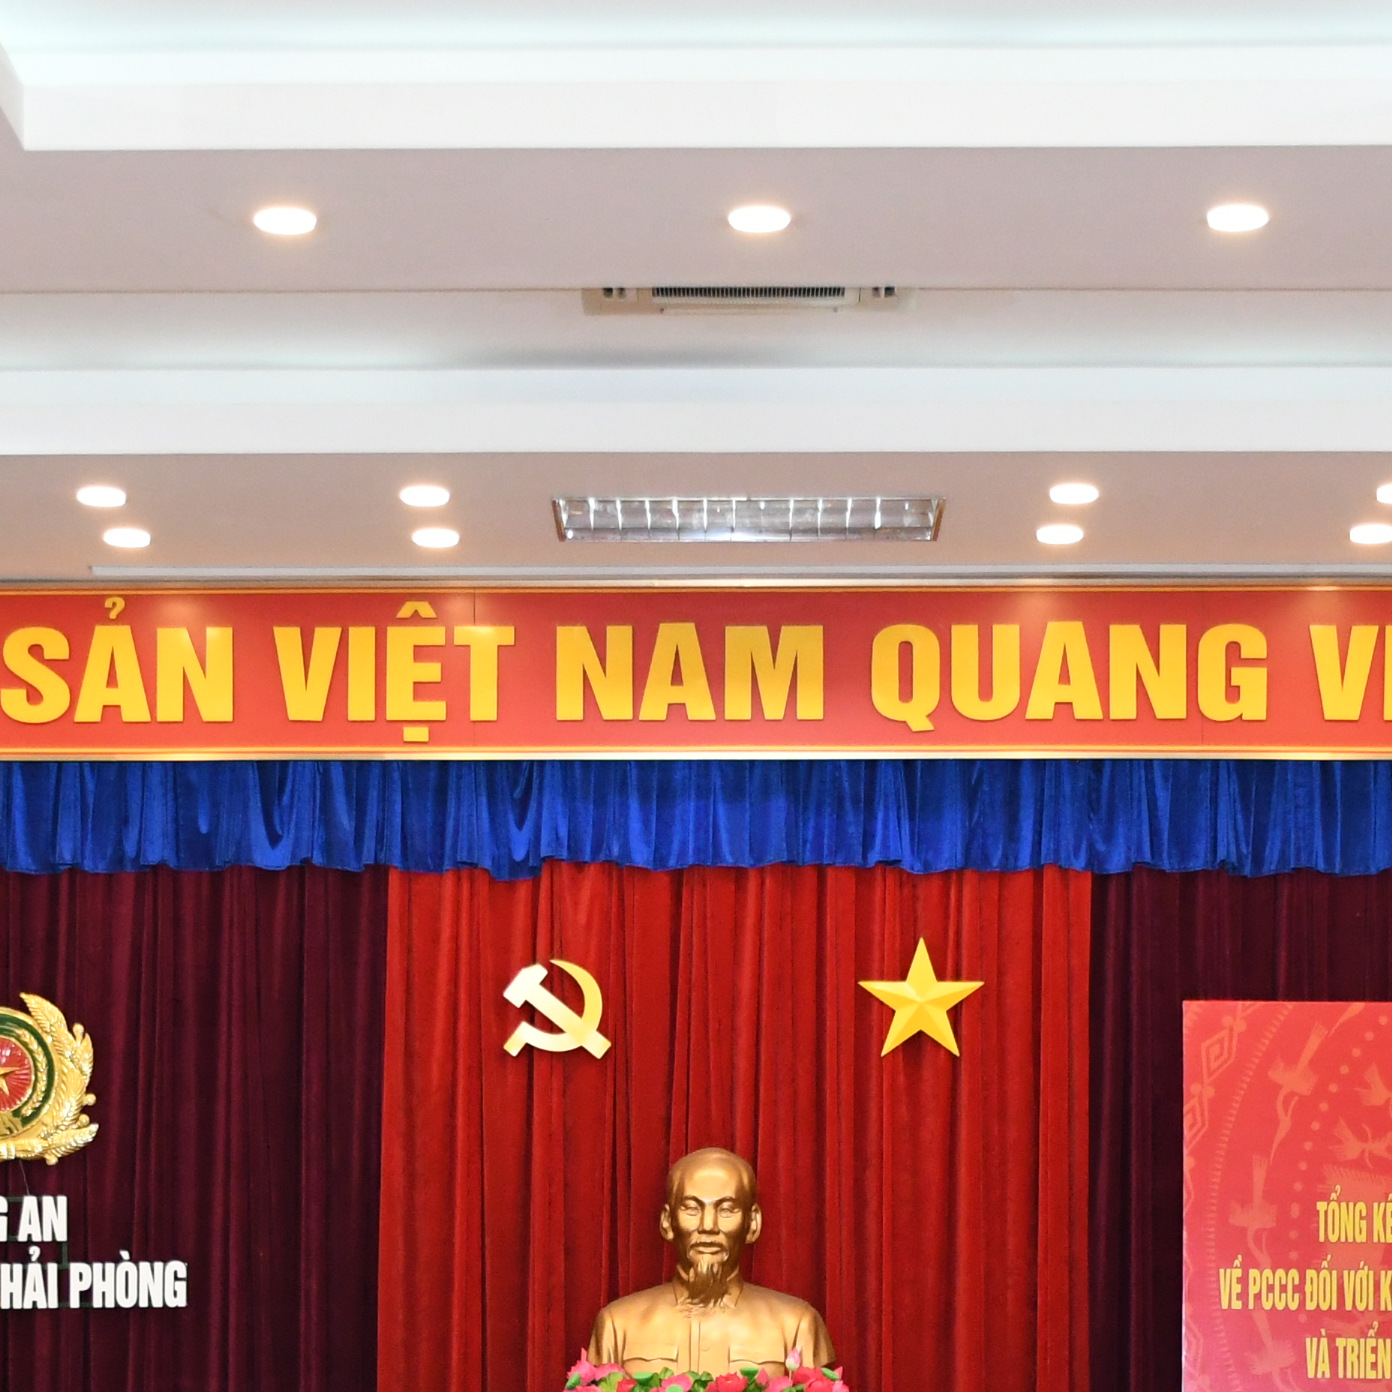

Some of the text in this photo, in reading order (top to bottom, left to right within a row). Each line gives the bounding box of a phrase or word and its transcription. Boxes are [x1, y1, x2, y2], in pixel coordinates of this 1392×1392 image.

[273, 603, 516, 744] VIỆT
[553, 624, 827, 724] NAM
[870, 619, 1271, 732] QUANG
[17, 1195, 67, 1241] AN
[1317, 1184, 1367, 1244] TỔNG
[0, 1246, 58, 1309] HẢI
[69, 1250, 187, 1308] PHÒNG
[1219, 1254, 1243, 1310] VỀ
[1248, 1268, 1300, 1311] PCCC
[1305, 1255, 1337, 1311] ĐỐI
[1343, 1261, 1374, 1311] VỚI
[1306, 1329, 1331, 1378] VÀ
[1336, 1321, 1391, 1379] TRIỂN
